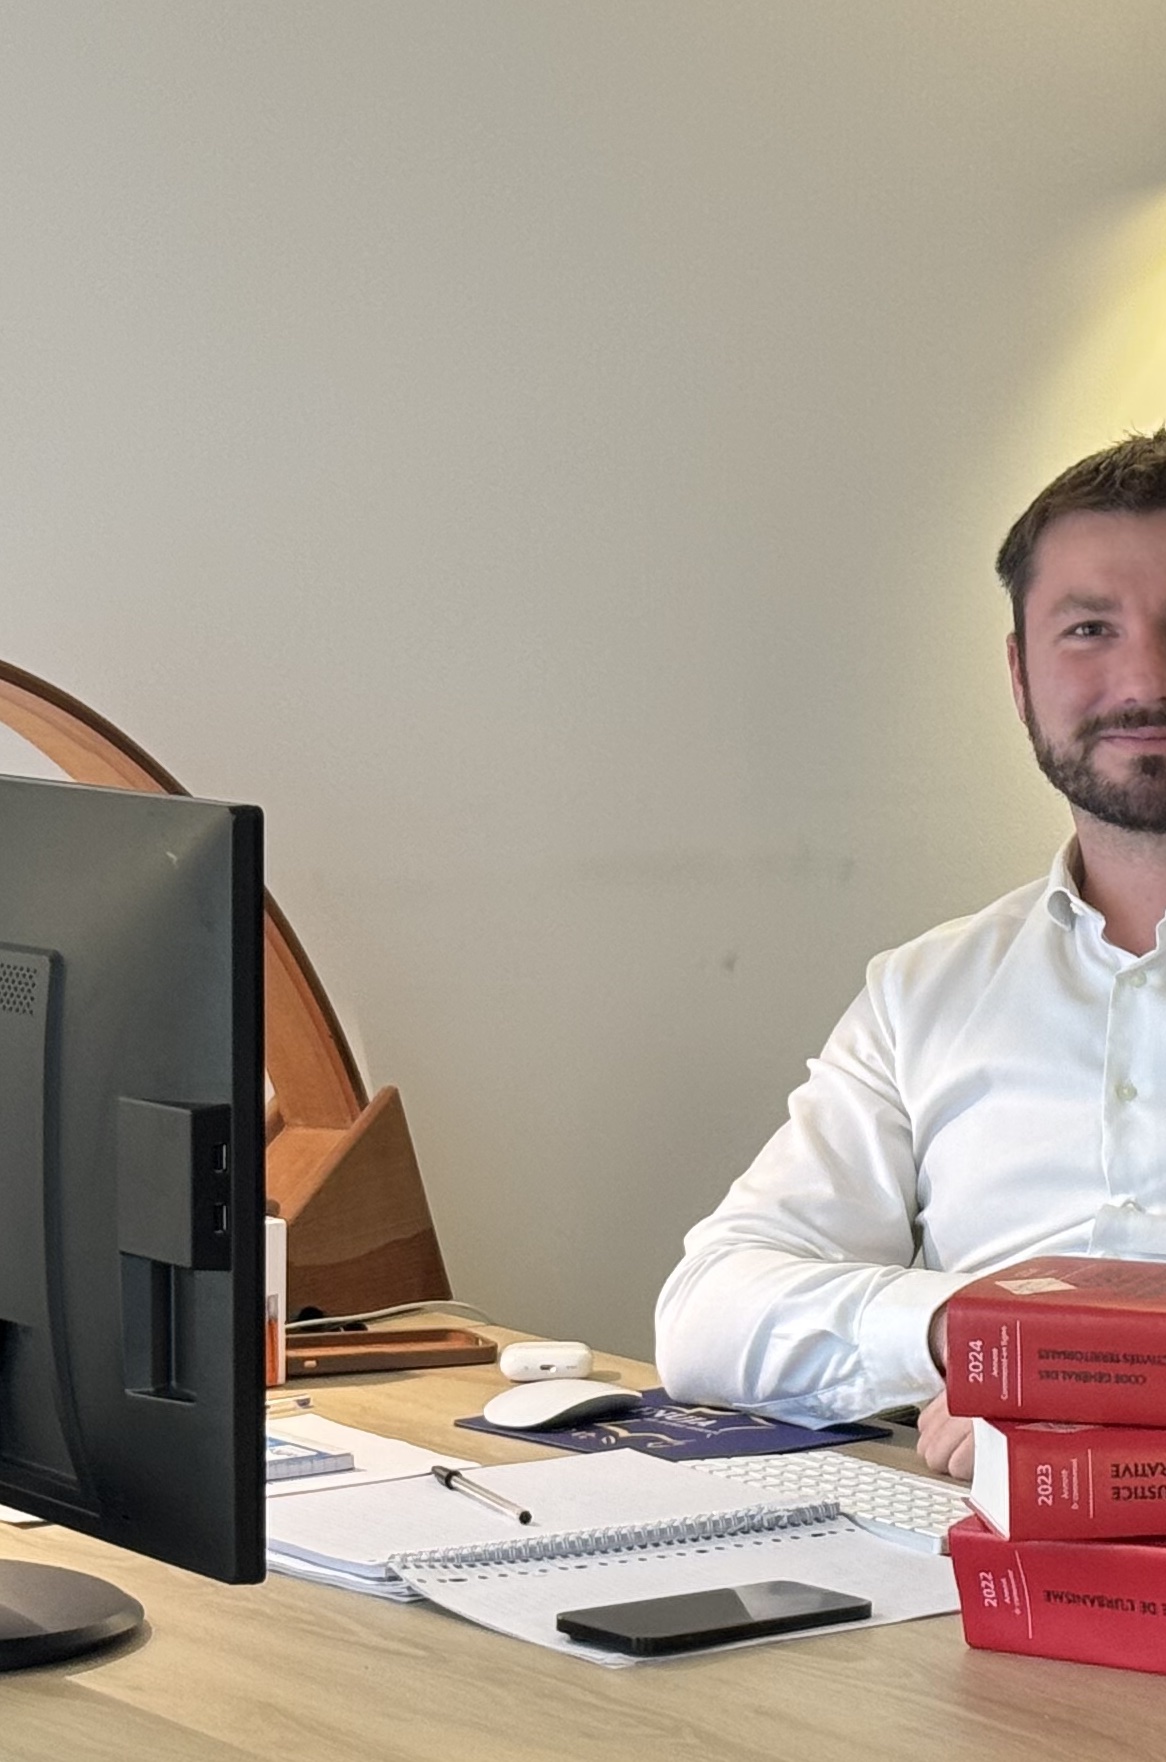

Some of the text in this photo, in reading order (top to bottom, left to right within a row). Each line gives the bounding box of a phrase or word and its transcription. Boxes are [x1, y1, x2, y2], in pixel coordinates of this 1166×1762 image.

[968, 1339, 984, 1383] 2024
[1112, 1373, 1147, 1386] CODE
[1036, 1464, 1053, 1506] 2023
[979, 1571, 998, 1608] 2022
[1043, 1590, 1136, 1612] L'URBANISME
[1140, 1601, 1158, 1616] DE
